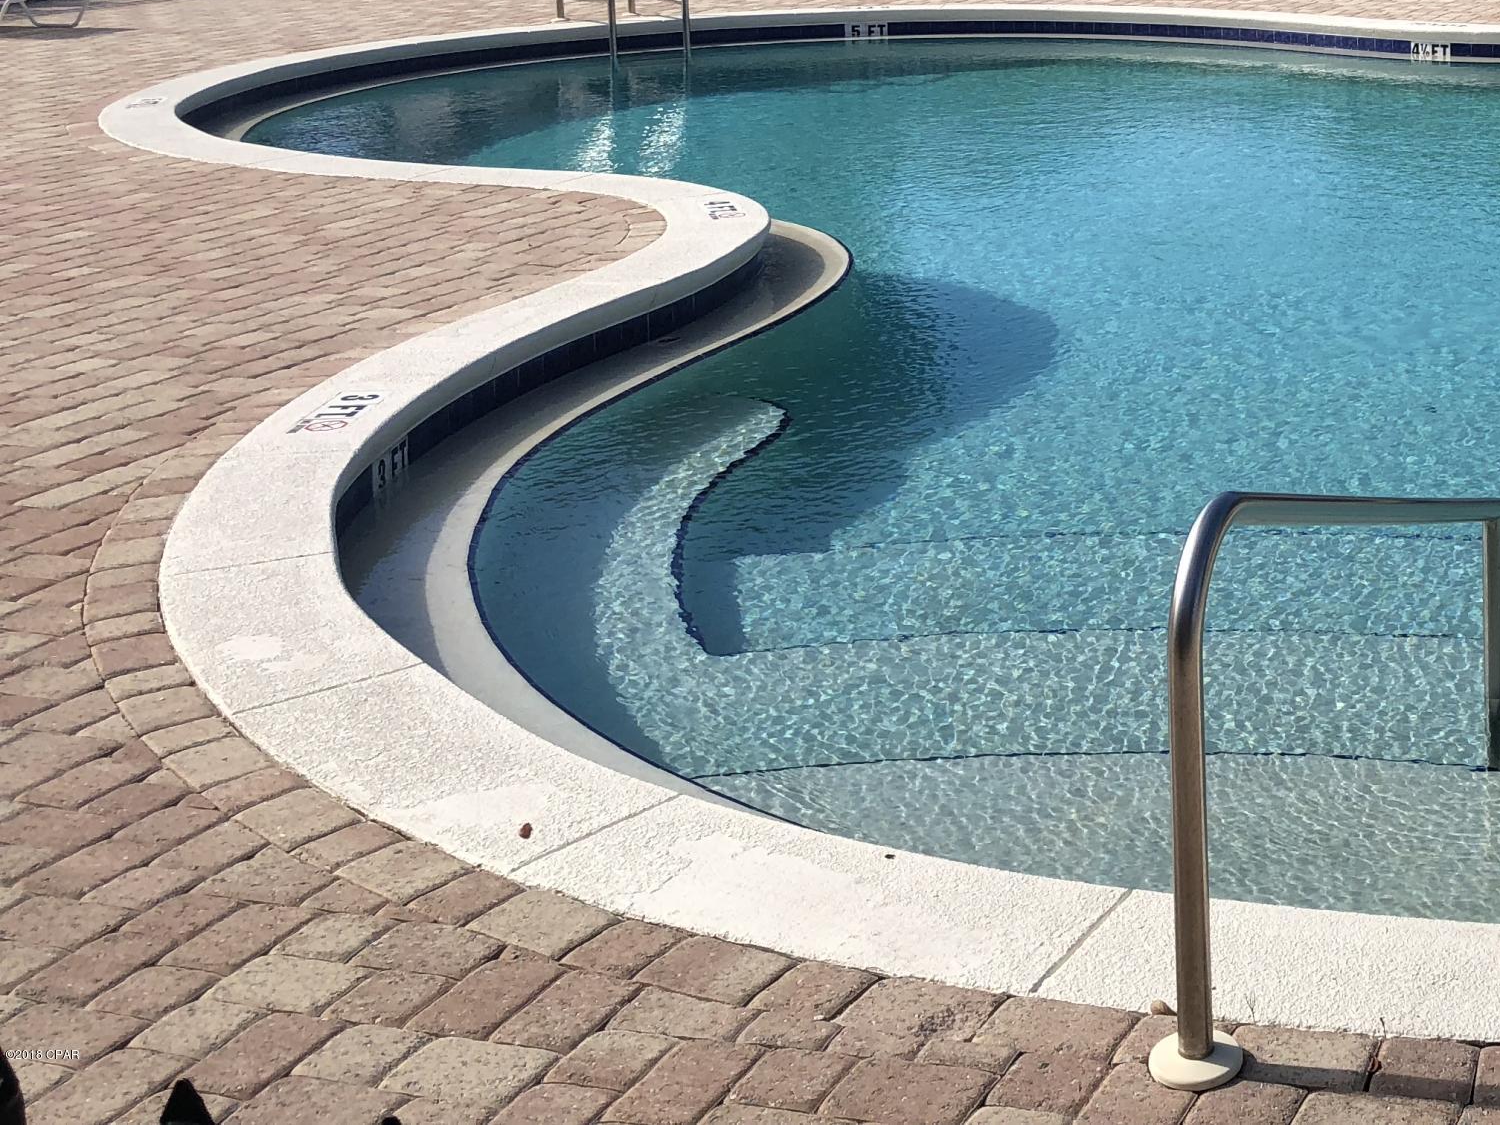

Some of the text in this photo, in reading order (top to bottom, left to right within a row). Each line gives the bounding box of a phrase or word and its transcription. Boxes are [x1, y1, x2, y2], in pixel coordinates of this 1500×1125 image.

[852, 24, 886, 37] 5 FT
[314, 405, 368, 418] FT
[378, 436, 408, 490] 3 FT
